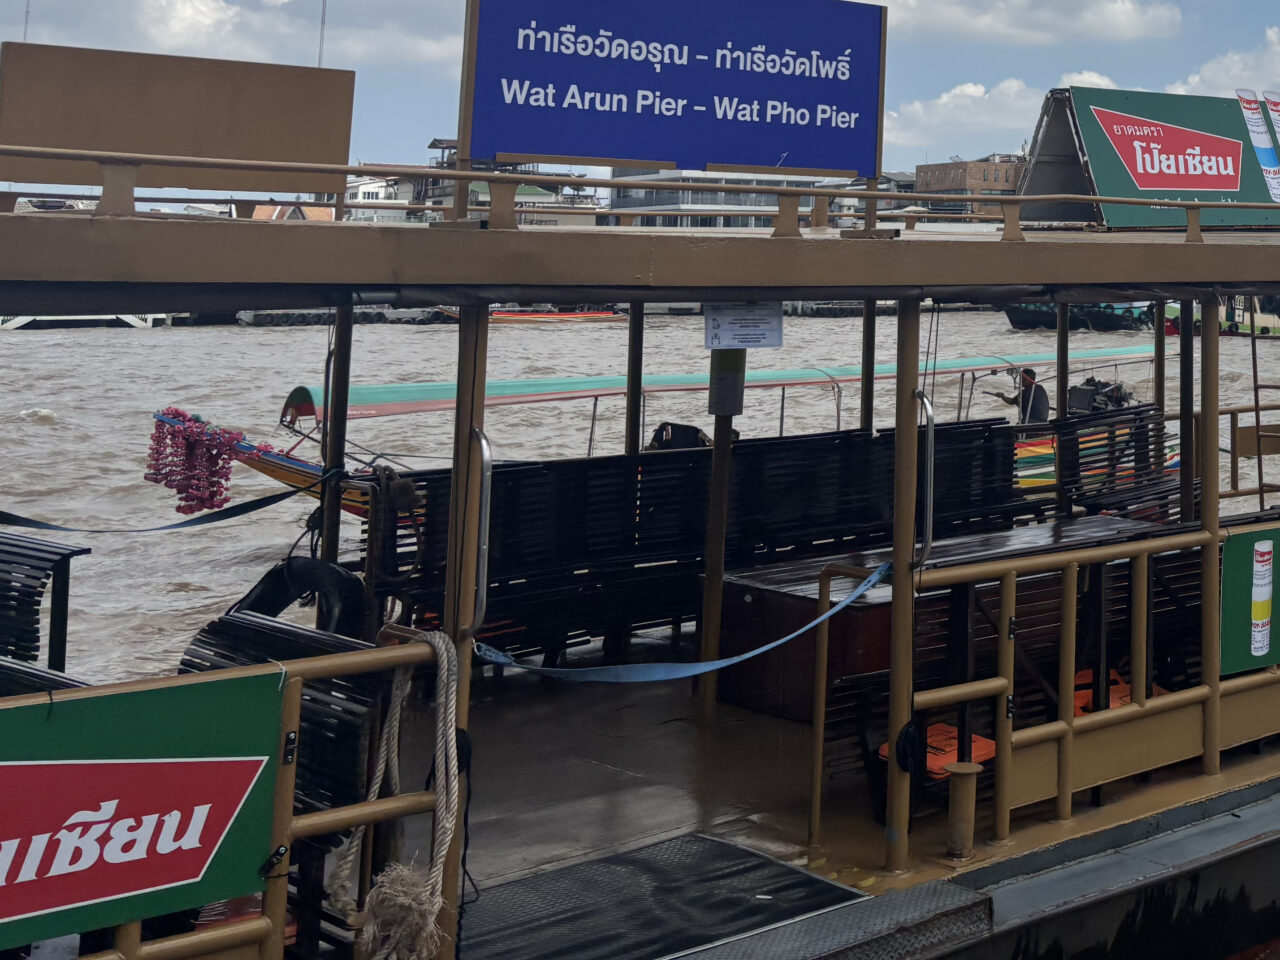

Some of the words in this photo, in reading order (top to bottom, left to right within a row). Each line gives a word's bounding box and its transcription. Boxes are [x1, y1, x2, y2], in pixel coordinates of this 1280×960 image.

[517, 20, 689, 73] ท่าเรือวัดอรุณ
[715, 41, 852, 81] ท่าเรือวัดโพธิ์
[501, 78, 556, 107] Wat
[562, 84, 628, 113] Arun
[636, 89, 687, 116] Pier
[713, 95, 760, 122] Wat
[766, 100, 810, 126] Pho
[816, 104, 860, 129] Pier
[1113, 124, 1164, 137] ยาดมตรา
[1133, 140, 1235, 176] โป๊ยเซียน
